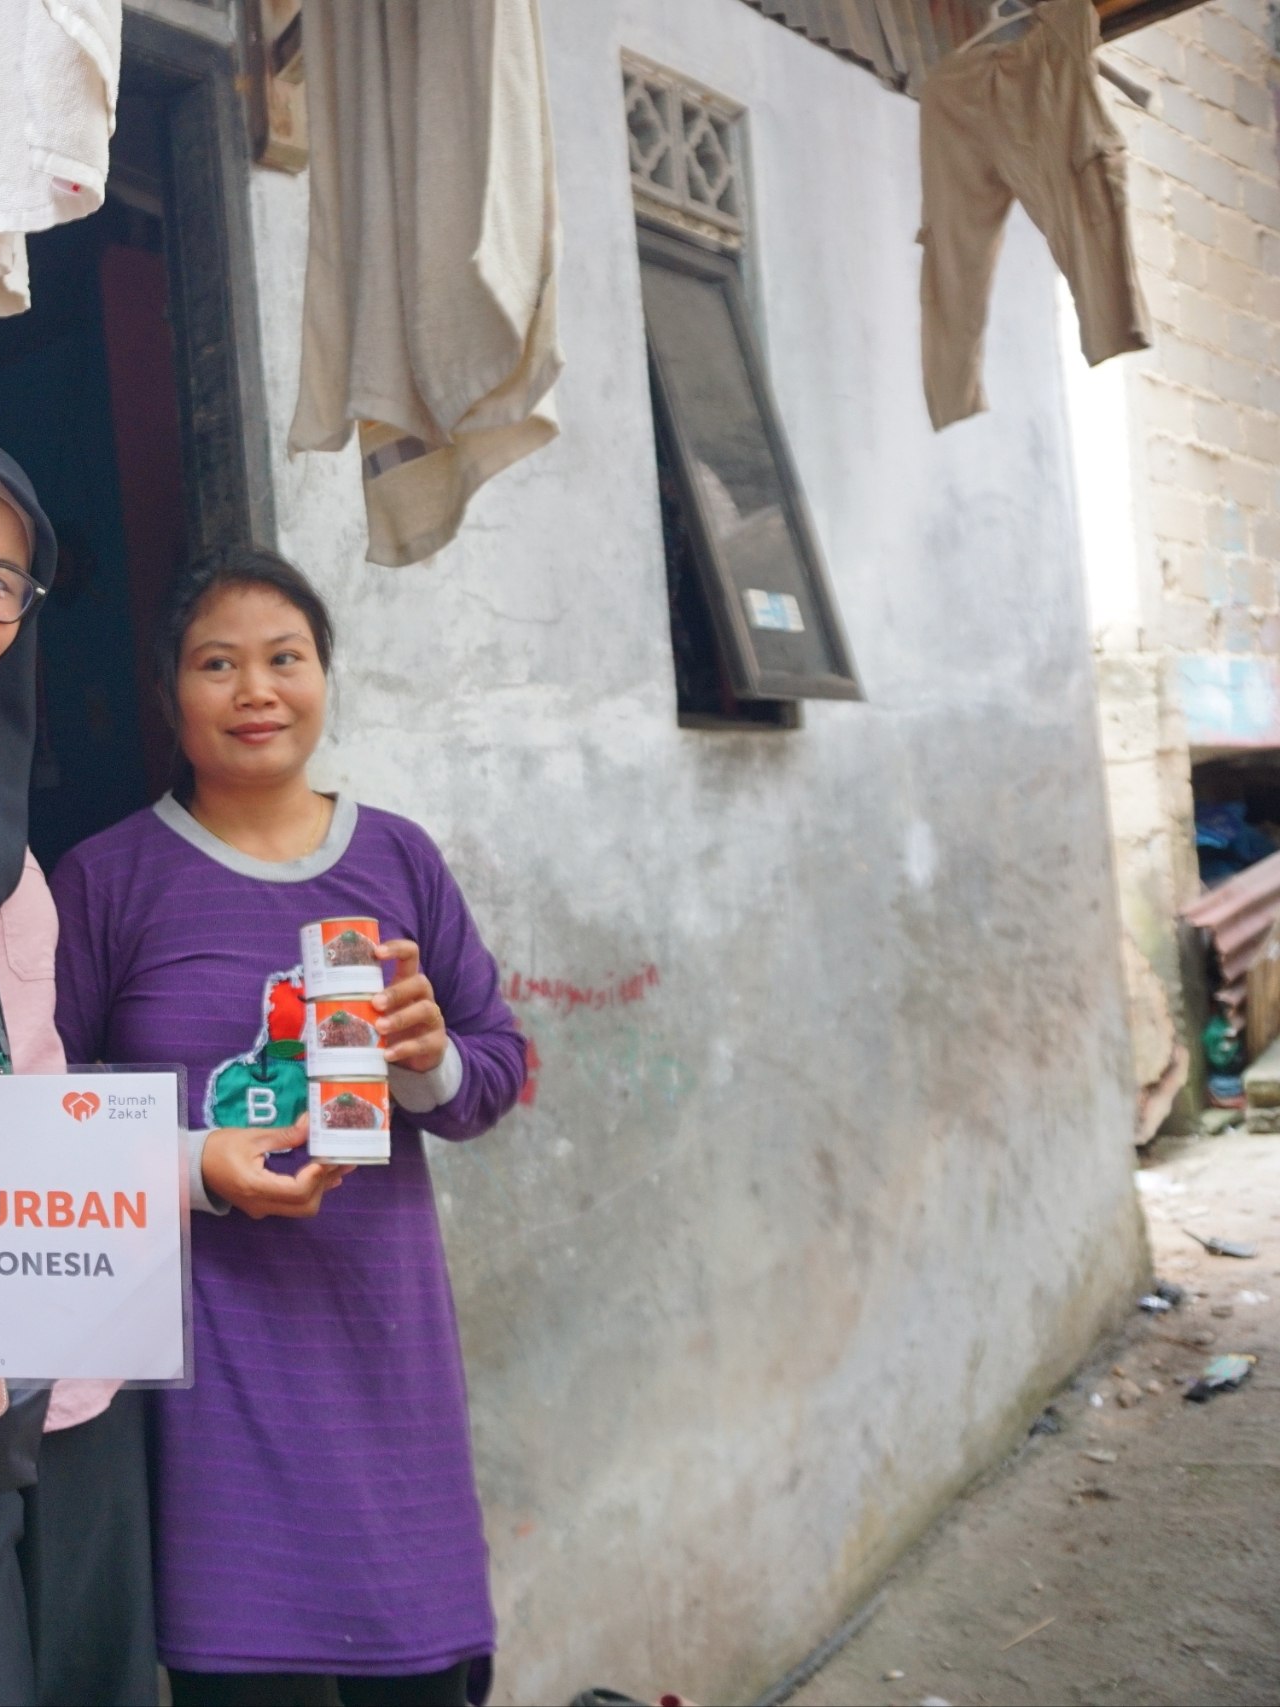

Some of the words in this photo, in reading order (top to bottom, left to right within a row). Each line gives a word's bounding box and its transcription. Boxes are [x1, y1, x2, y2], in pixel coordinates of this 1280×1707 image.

[108, 1095, 156, 1106] Rumah
[246, 1087, 277, 1125] B
[108, 1108, 148, 1119] Zakat
